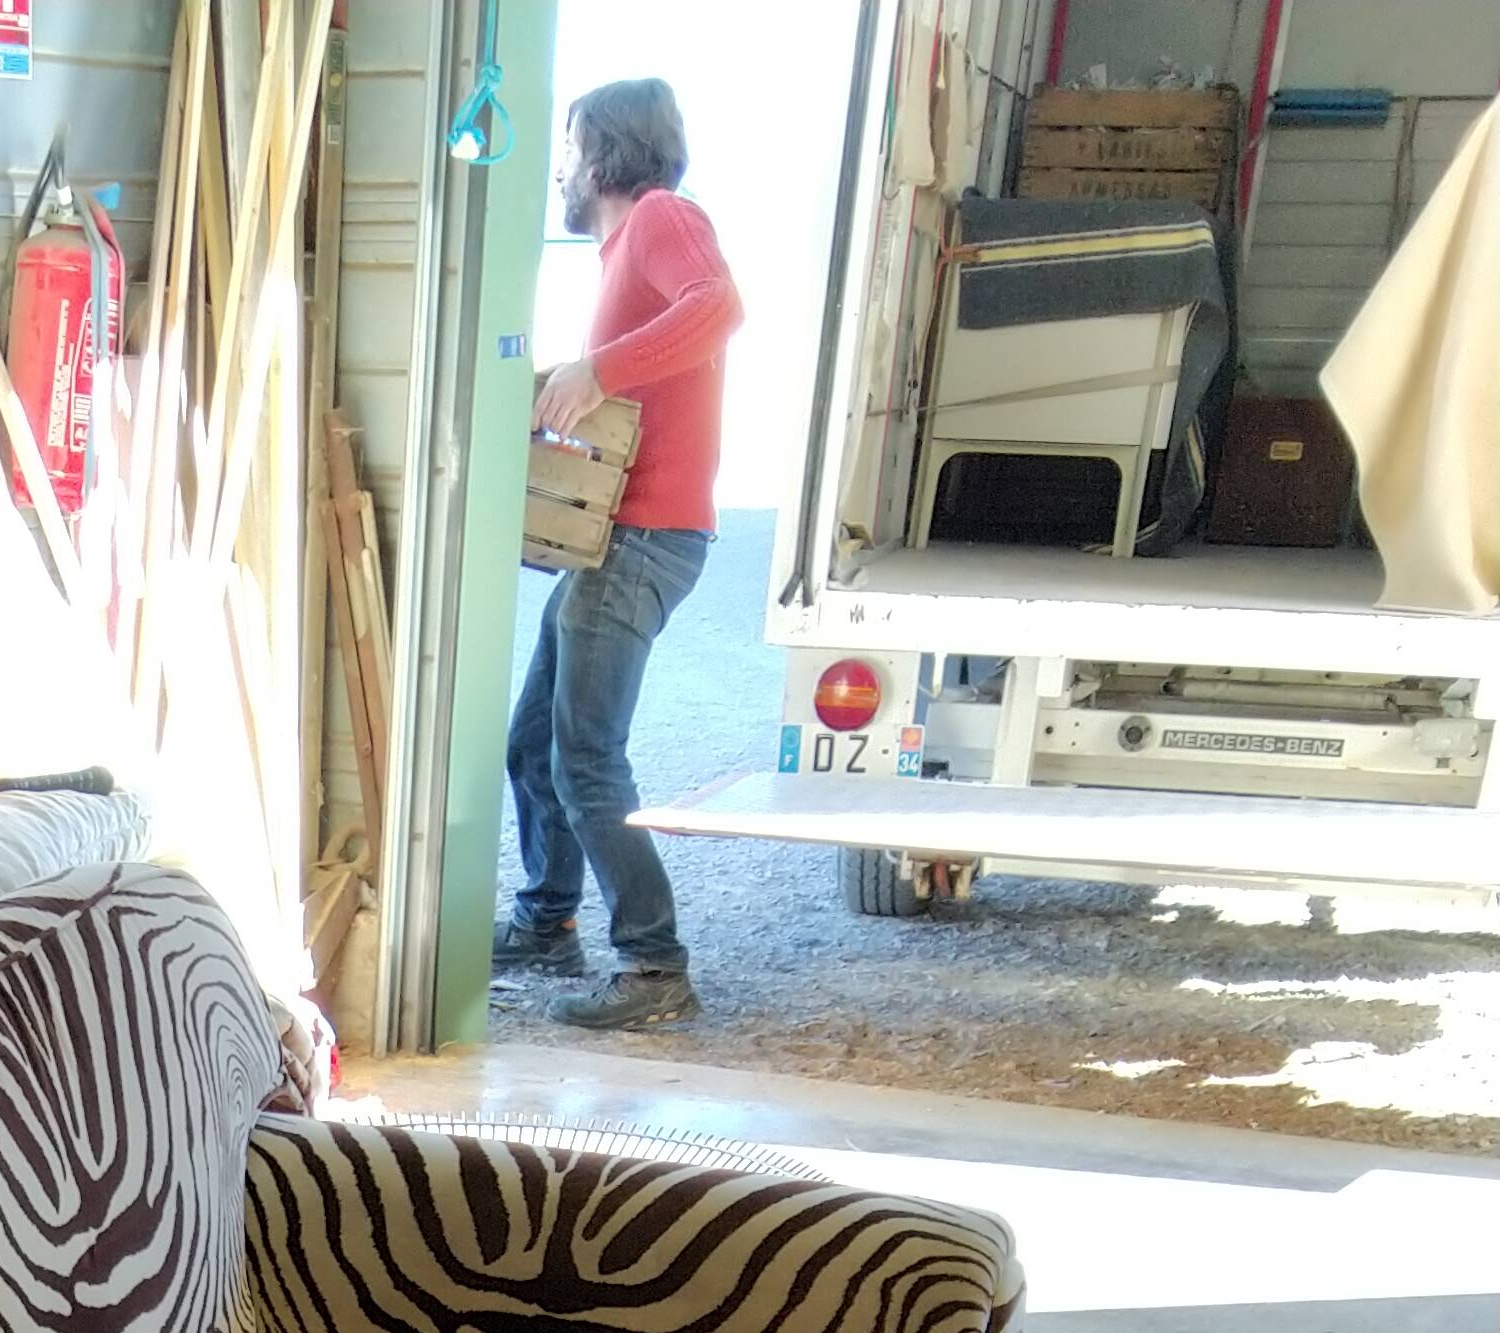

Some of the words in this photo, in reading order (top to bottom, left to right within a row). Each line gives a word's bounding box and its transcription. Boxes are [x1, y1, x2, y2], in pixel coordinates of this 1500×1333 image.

[1164, 731, 1344, 756] MERCEDES-BENZ
[783, 754, 794, 767] F
[899, 753, 918, 772] 34
